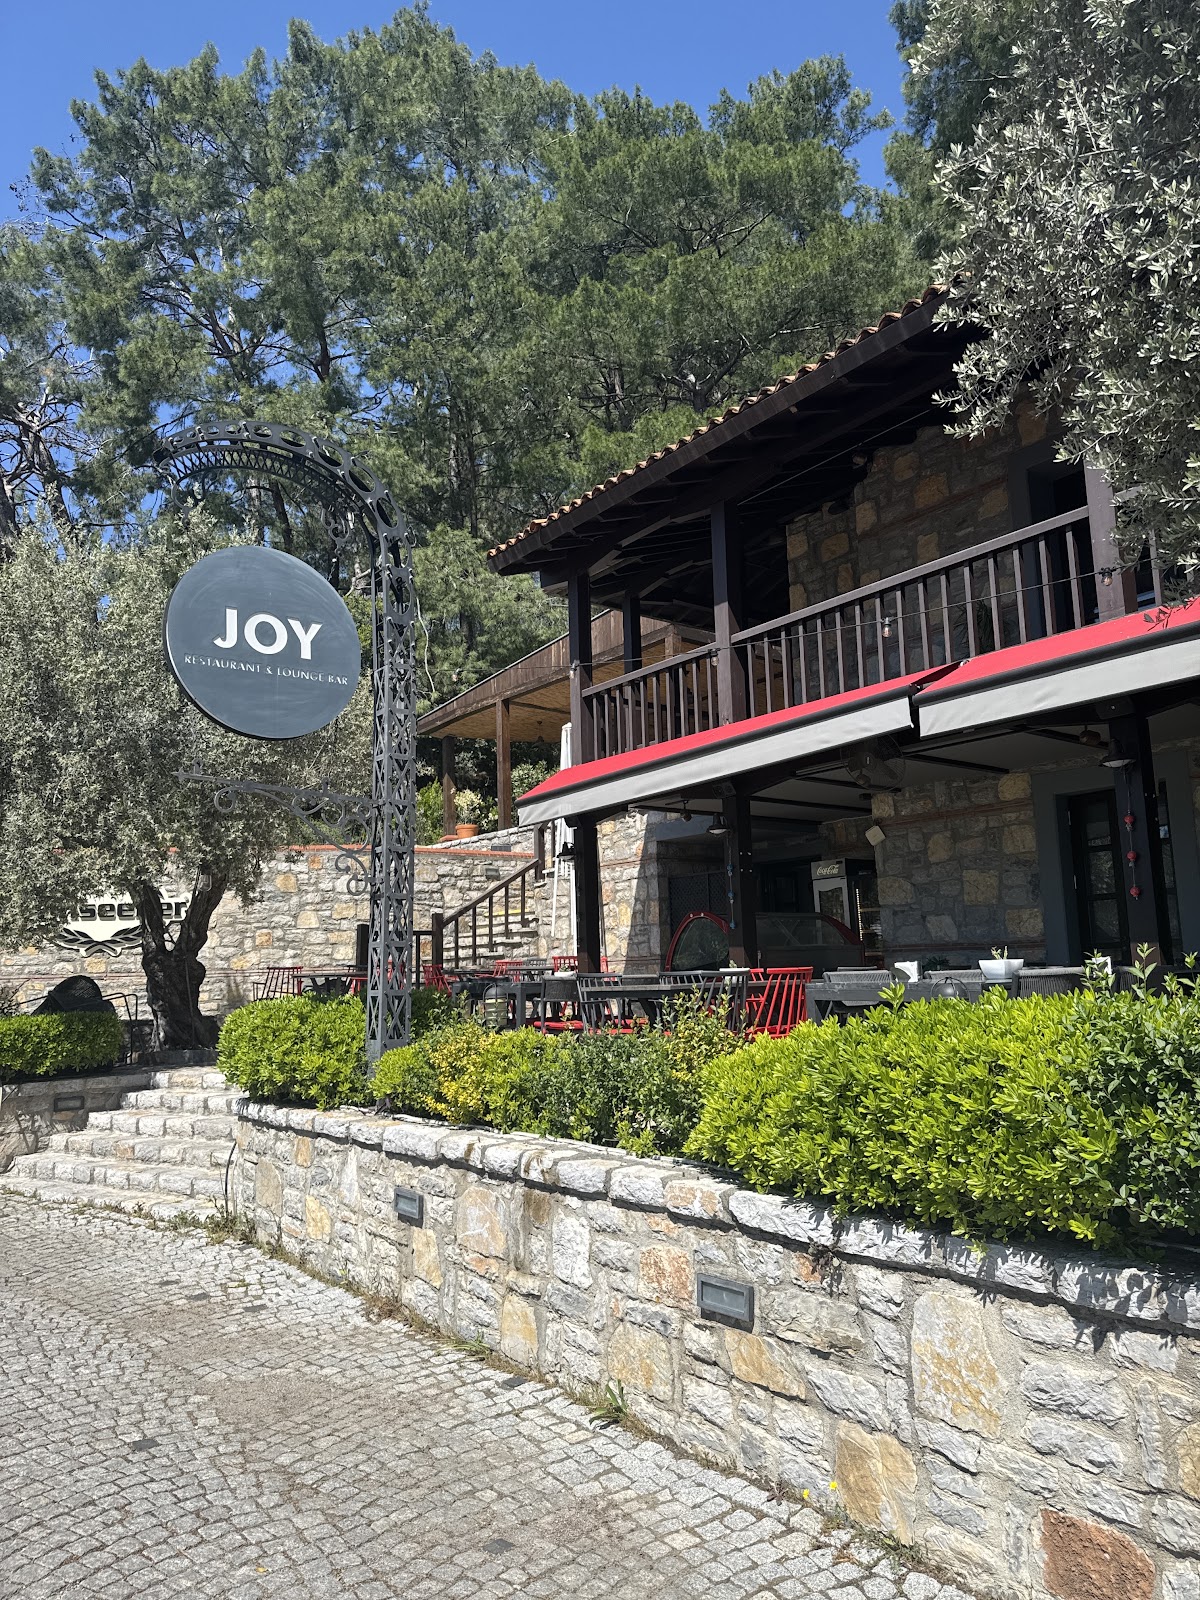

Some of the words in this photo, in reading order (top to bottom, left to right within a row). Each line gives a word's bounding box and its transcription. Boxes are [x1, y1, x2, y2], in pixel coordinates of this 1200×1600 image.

[213, 607, 323, 660] JOY
[184, 653, 261, 673] RESTAURANT
[265, 665, 273, 675] &
[277, 667, 325, 682] LOUNGE
[328, 675, 348, 686] BAR
